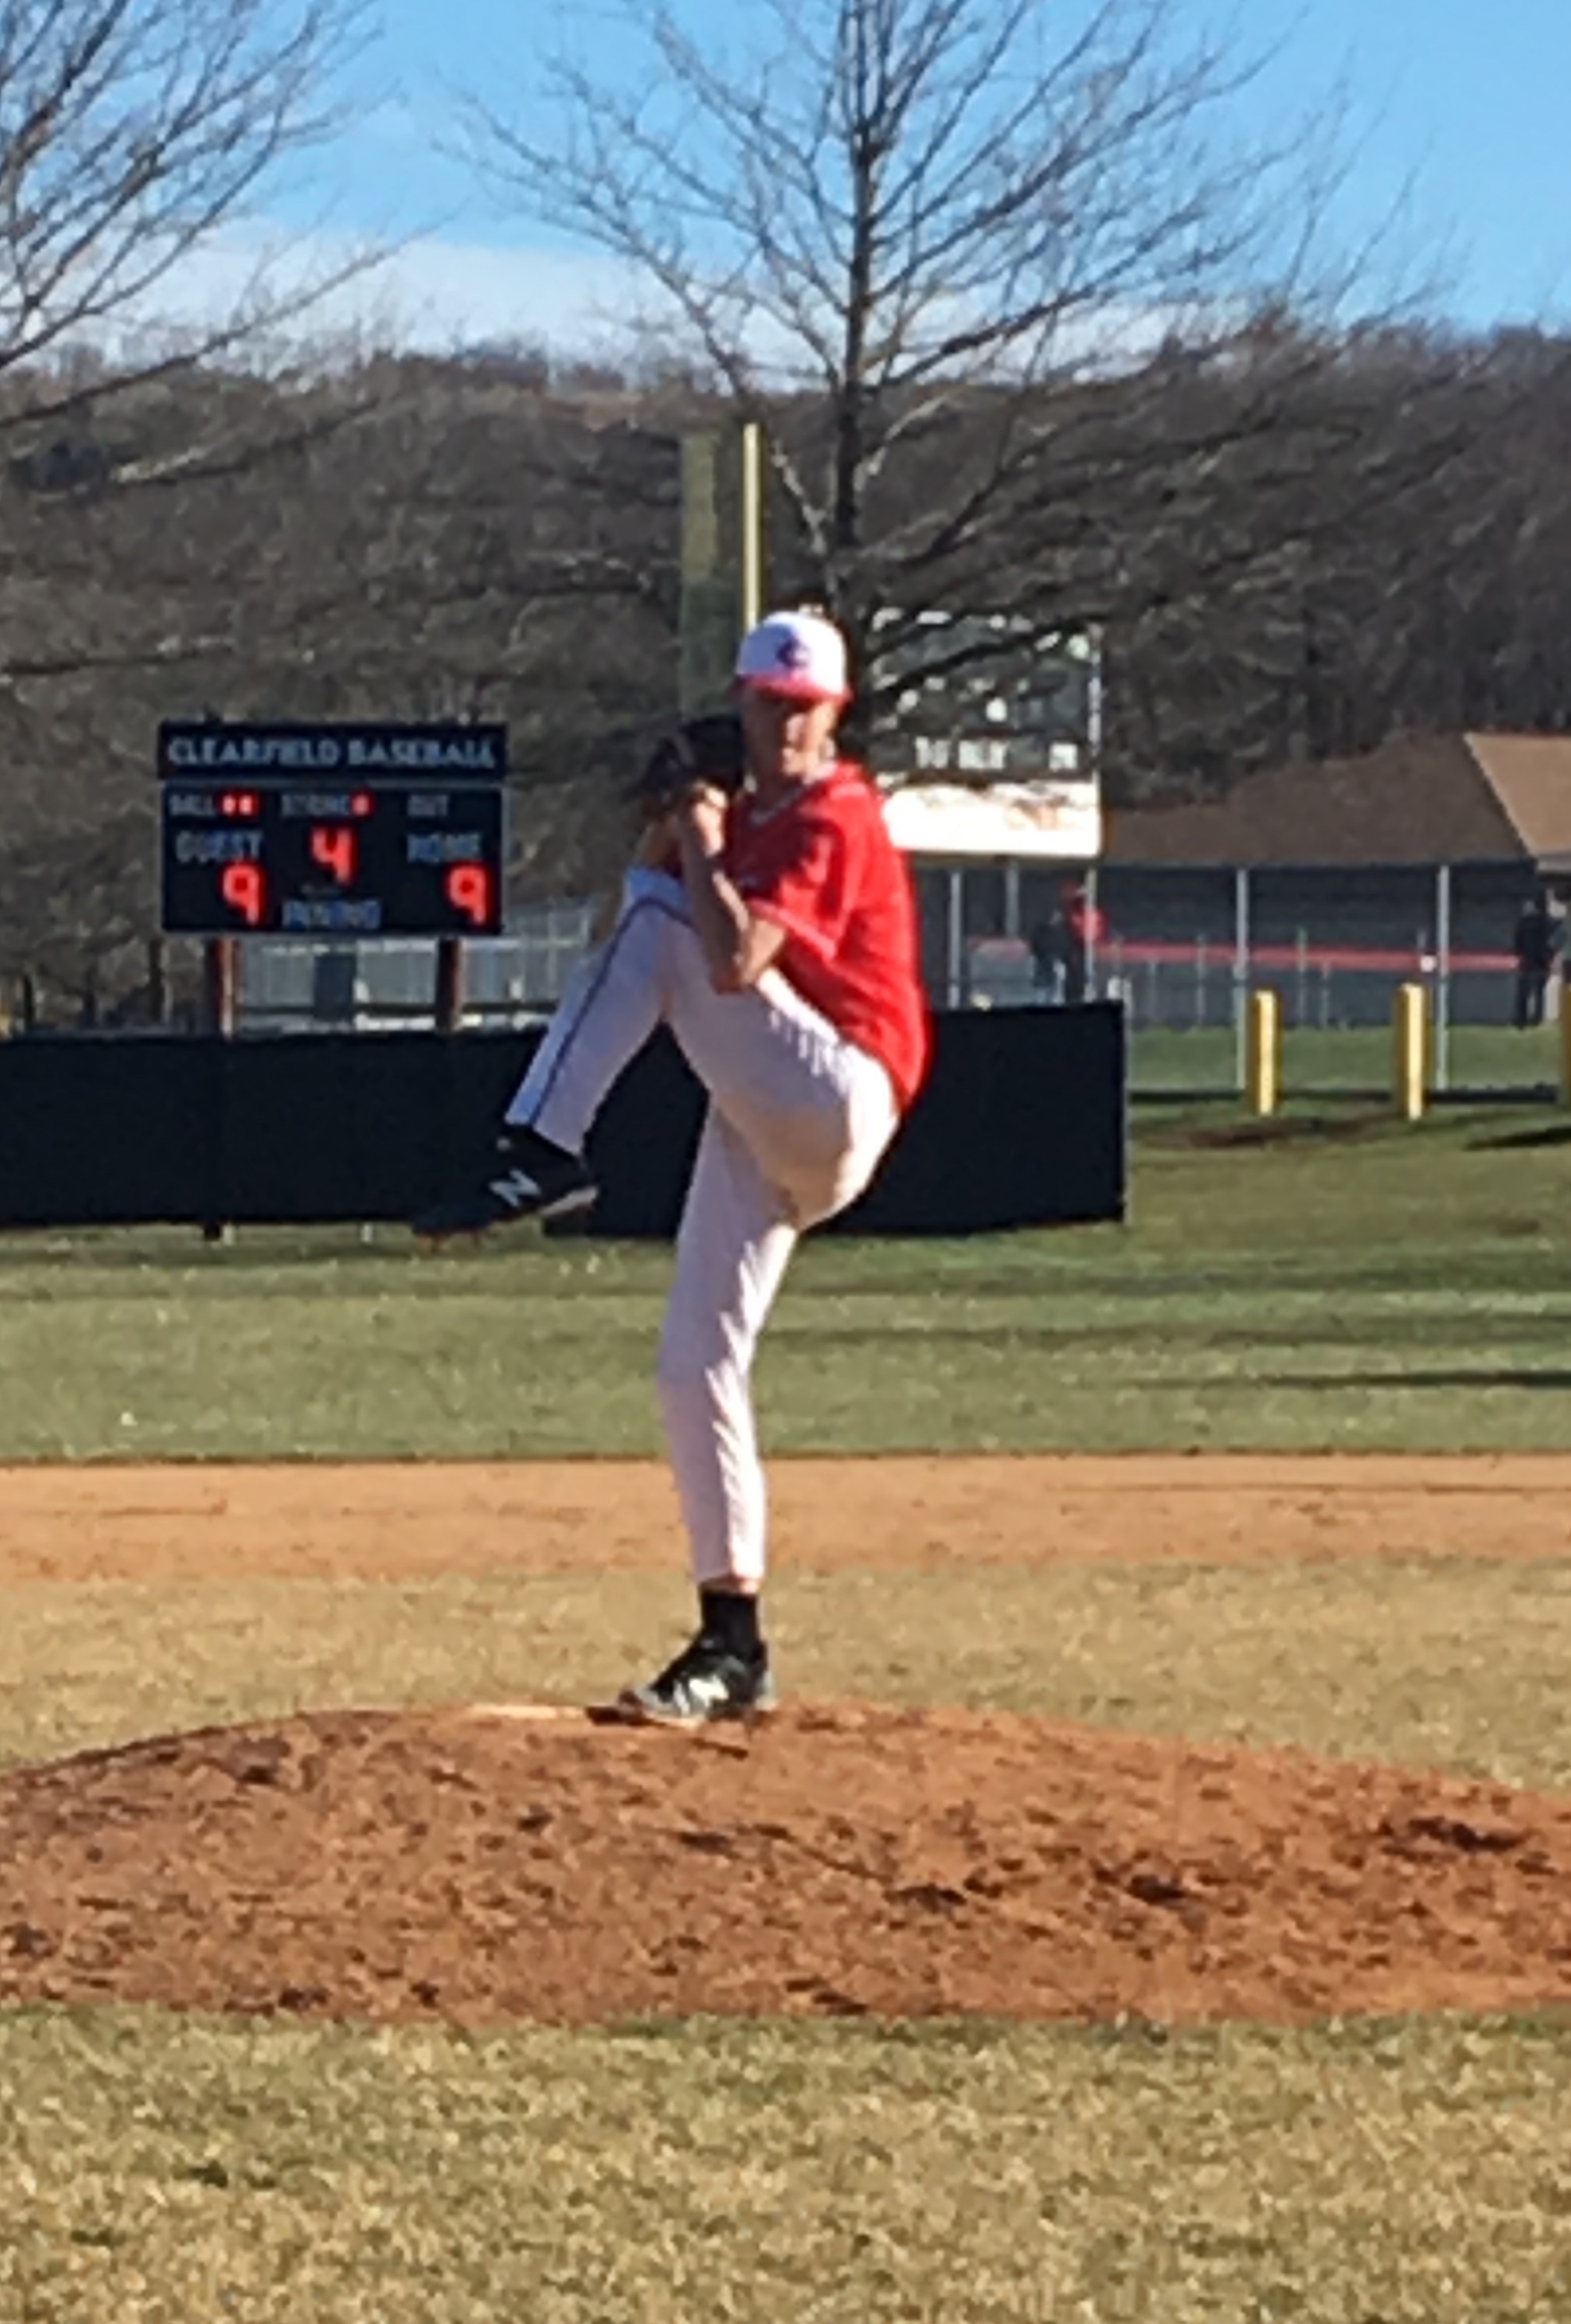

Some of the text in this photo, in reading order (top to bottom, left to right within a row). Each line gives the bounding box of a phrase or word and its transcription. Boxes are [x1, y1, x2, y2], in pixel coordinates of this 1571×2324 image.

[167, 739, 495, 768] CLEARFIELD BASEBALL
[311, 825, 353, 885] 4
[222, 864, 261, 925] 9
[447, 864, 488, 925] 9
